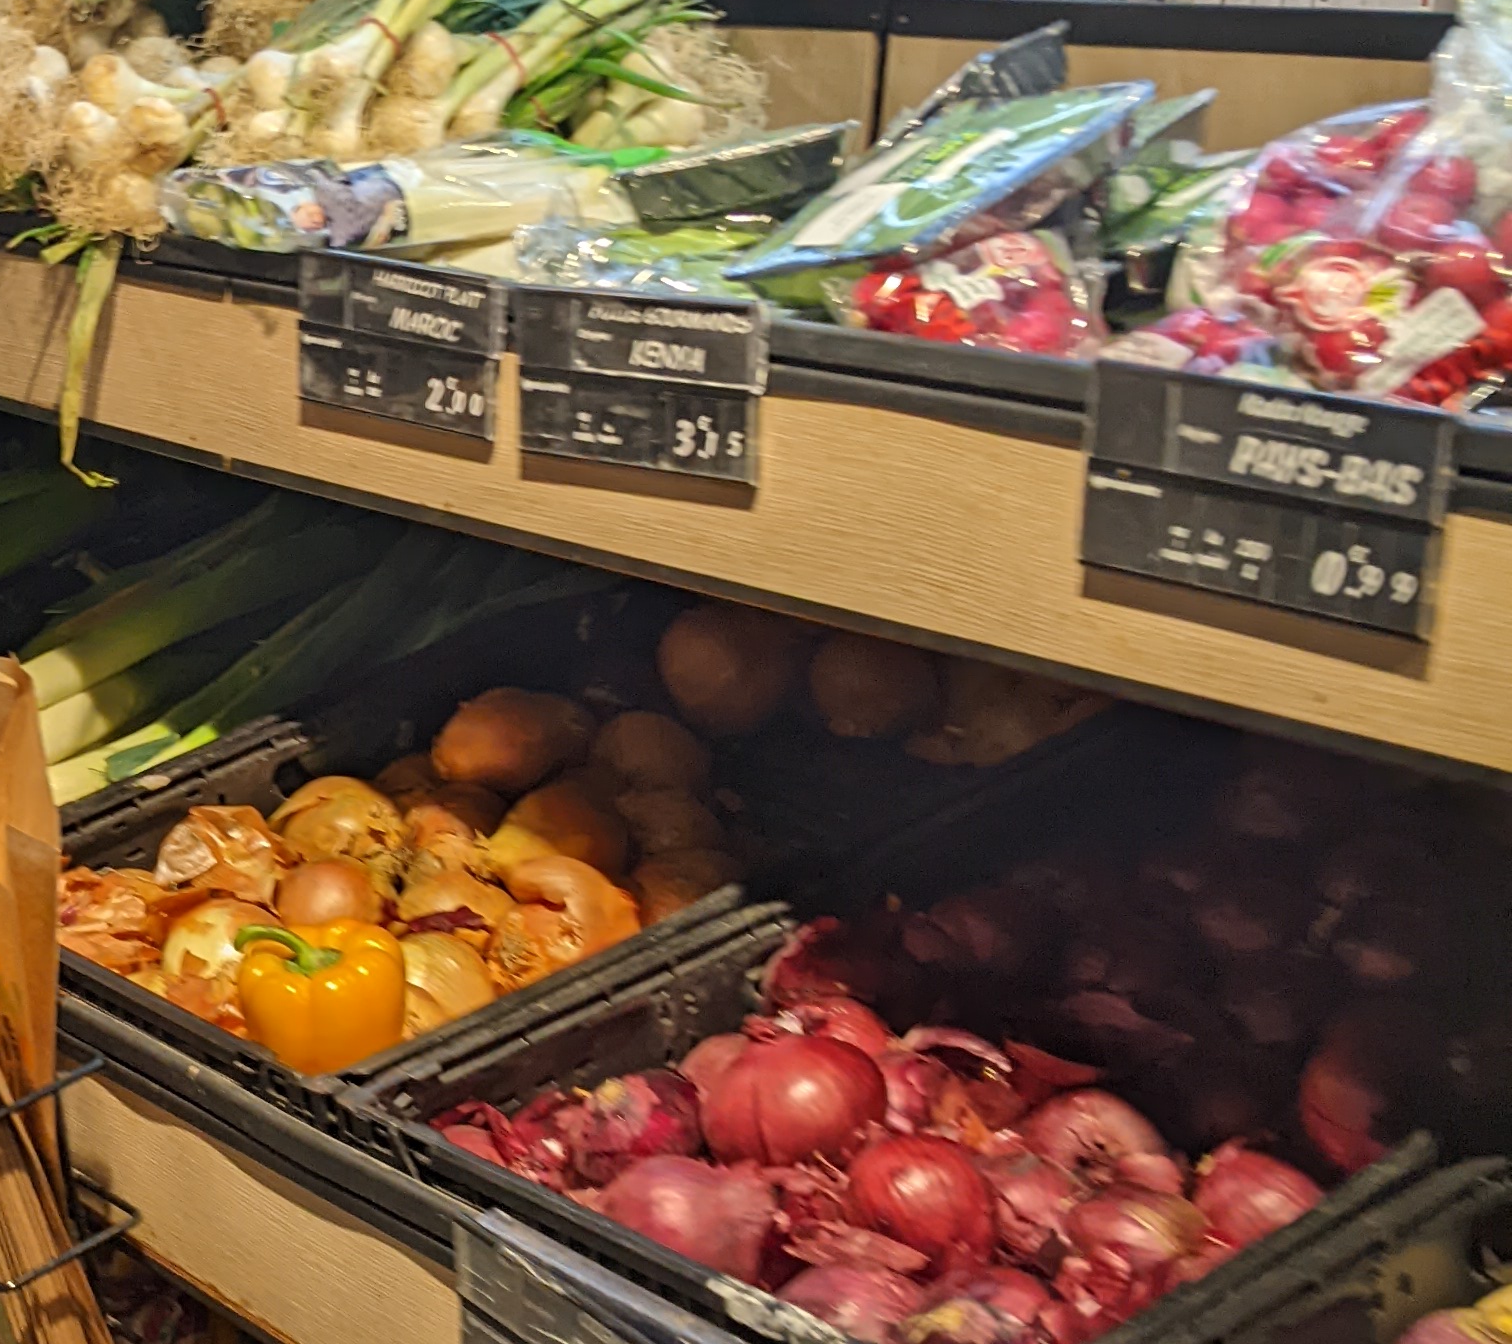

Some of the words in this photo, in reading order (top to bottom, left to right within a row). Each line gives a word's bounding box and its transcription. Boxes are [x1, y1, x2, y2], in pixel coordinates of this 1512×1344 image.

[389, 307, 464, 342] MAROC
[628, 340, 707, 375] KENYA
[1228, 435, 1425, 506] PAYS-BAS
